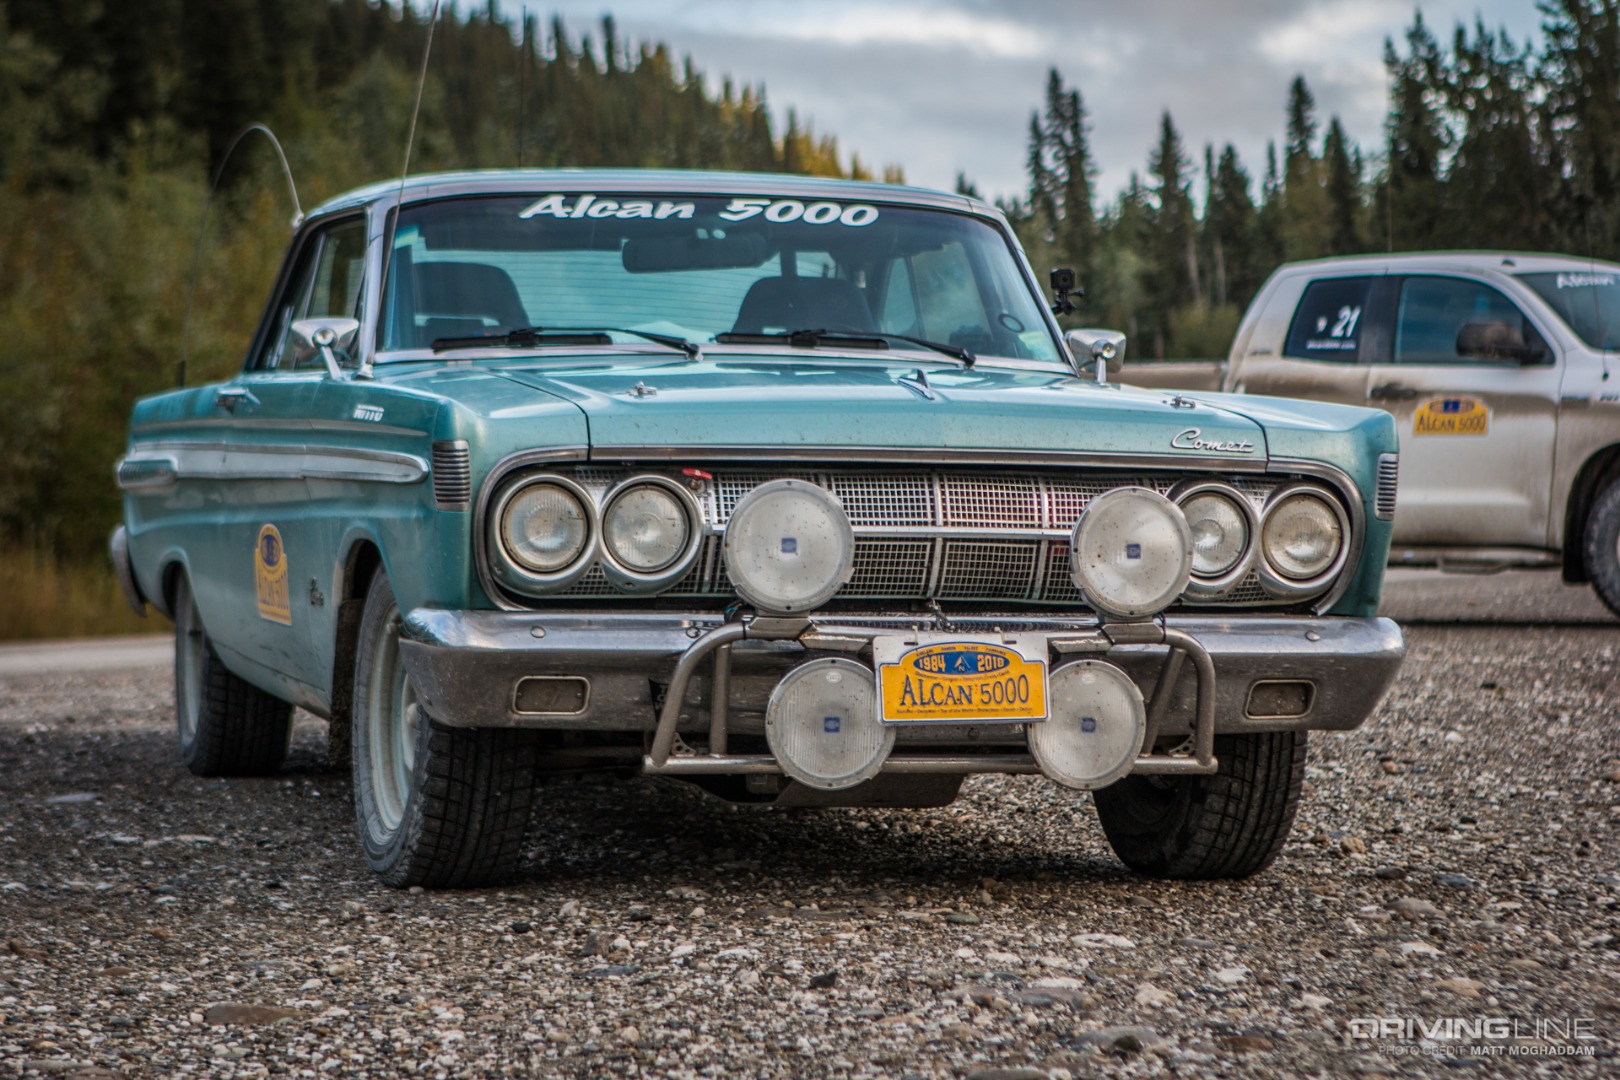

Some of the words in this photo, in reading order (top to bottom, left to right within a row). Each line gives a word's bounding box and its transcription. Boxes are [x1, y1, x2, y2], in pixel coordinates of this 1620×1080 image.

[518, 194, 696, 220] Alcan
[718, 198, 880, 226] 5000
[1331, 304, 1361, 337] 21
[1416, 414, 1455, 431] ALCAN
[1459, 413, 1486, 431] 5000
[1171, 427, 1254, 453] Comet
[918, 655, 946, 673] 1984
[977, 654, 1005, 672] 2018
[900, 674, 973, 706] ALCAN
[980, 674, 1029, 705] 5000
